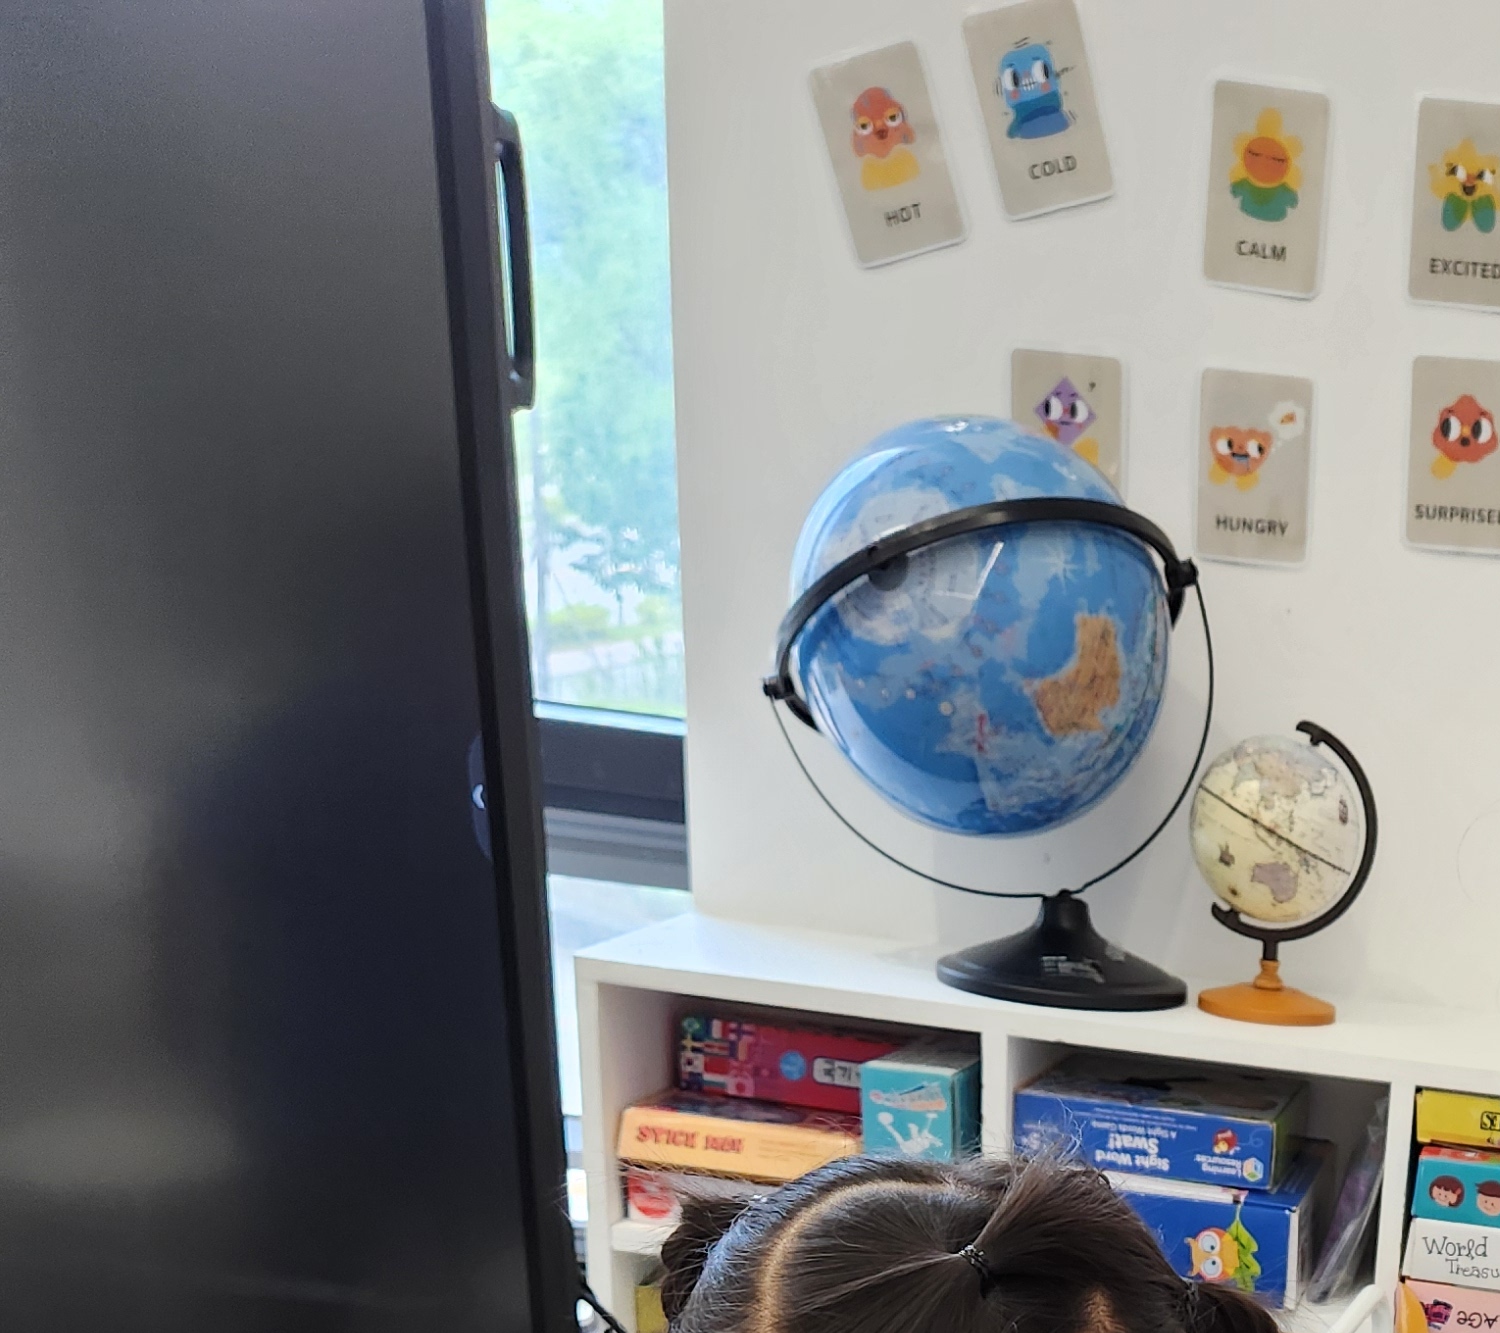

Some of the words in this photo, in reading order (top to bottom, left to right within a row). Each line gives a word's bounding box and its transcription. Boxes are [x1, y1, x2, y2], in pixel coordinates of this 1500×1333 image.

[1028, 155, 1077, 180] COLD
[884, 202, 922, 227] HOT
[1235, 240, 1287, 261] CALM
[1215, 514, 1288, 537] HUNGRY
[1108, 1132, 1159, 1154] Swat!
[1096, 1149, 1132, 1168] Word
[1136, 1155, 1170, 1172] Sight
[1202, 1162, 1241, 1178] Learning
[1422, 1235, 1488, 1260] World
